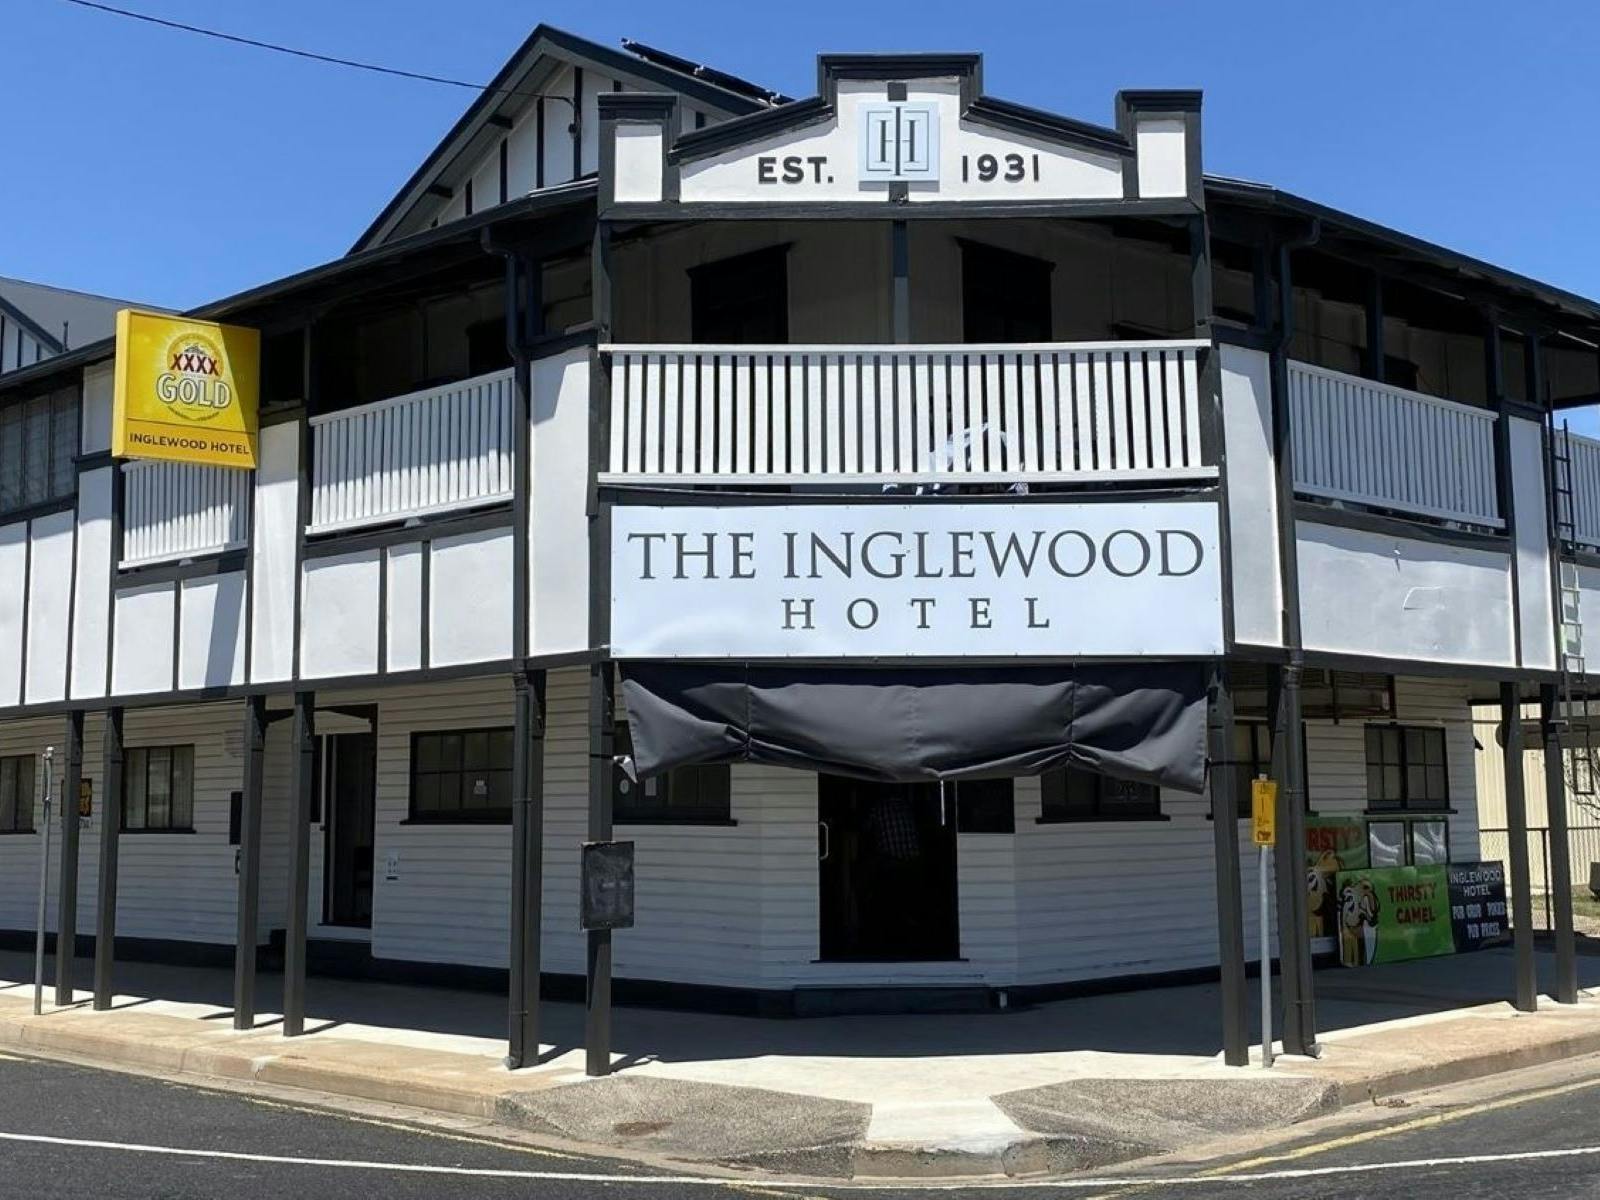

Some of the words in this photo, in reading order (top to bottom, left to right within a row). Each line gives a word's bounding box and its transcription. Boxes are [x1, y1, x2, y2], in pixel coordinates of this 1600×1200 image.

[758, 156, 834, 184] EST.
[961, 153, 1040, 183] 1931
[170, 353, 219, 376] XXXX
[156, 372, 232, 408] GOLD
[129, 432, 207, 450] INGLEWOOD
[210, 441, 249, 454] HOTEL
[627, 532, 756, 580] THE
[783, 529, 1204, 579] INGLEWOOD
[781, 596, 1050, 629] HOTEL
[1450, 869, 1502, 884] INGLEWOOD
[1388, 882, 1436, 903] THIRSTY
[1463, 884, 1491, 897] HOTEL
[1396, 906, 1436, 924] CAMEL
